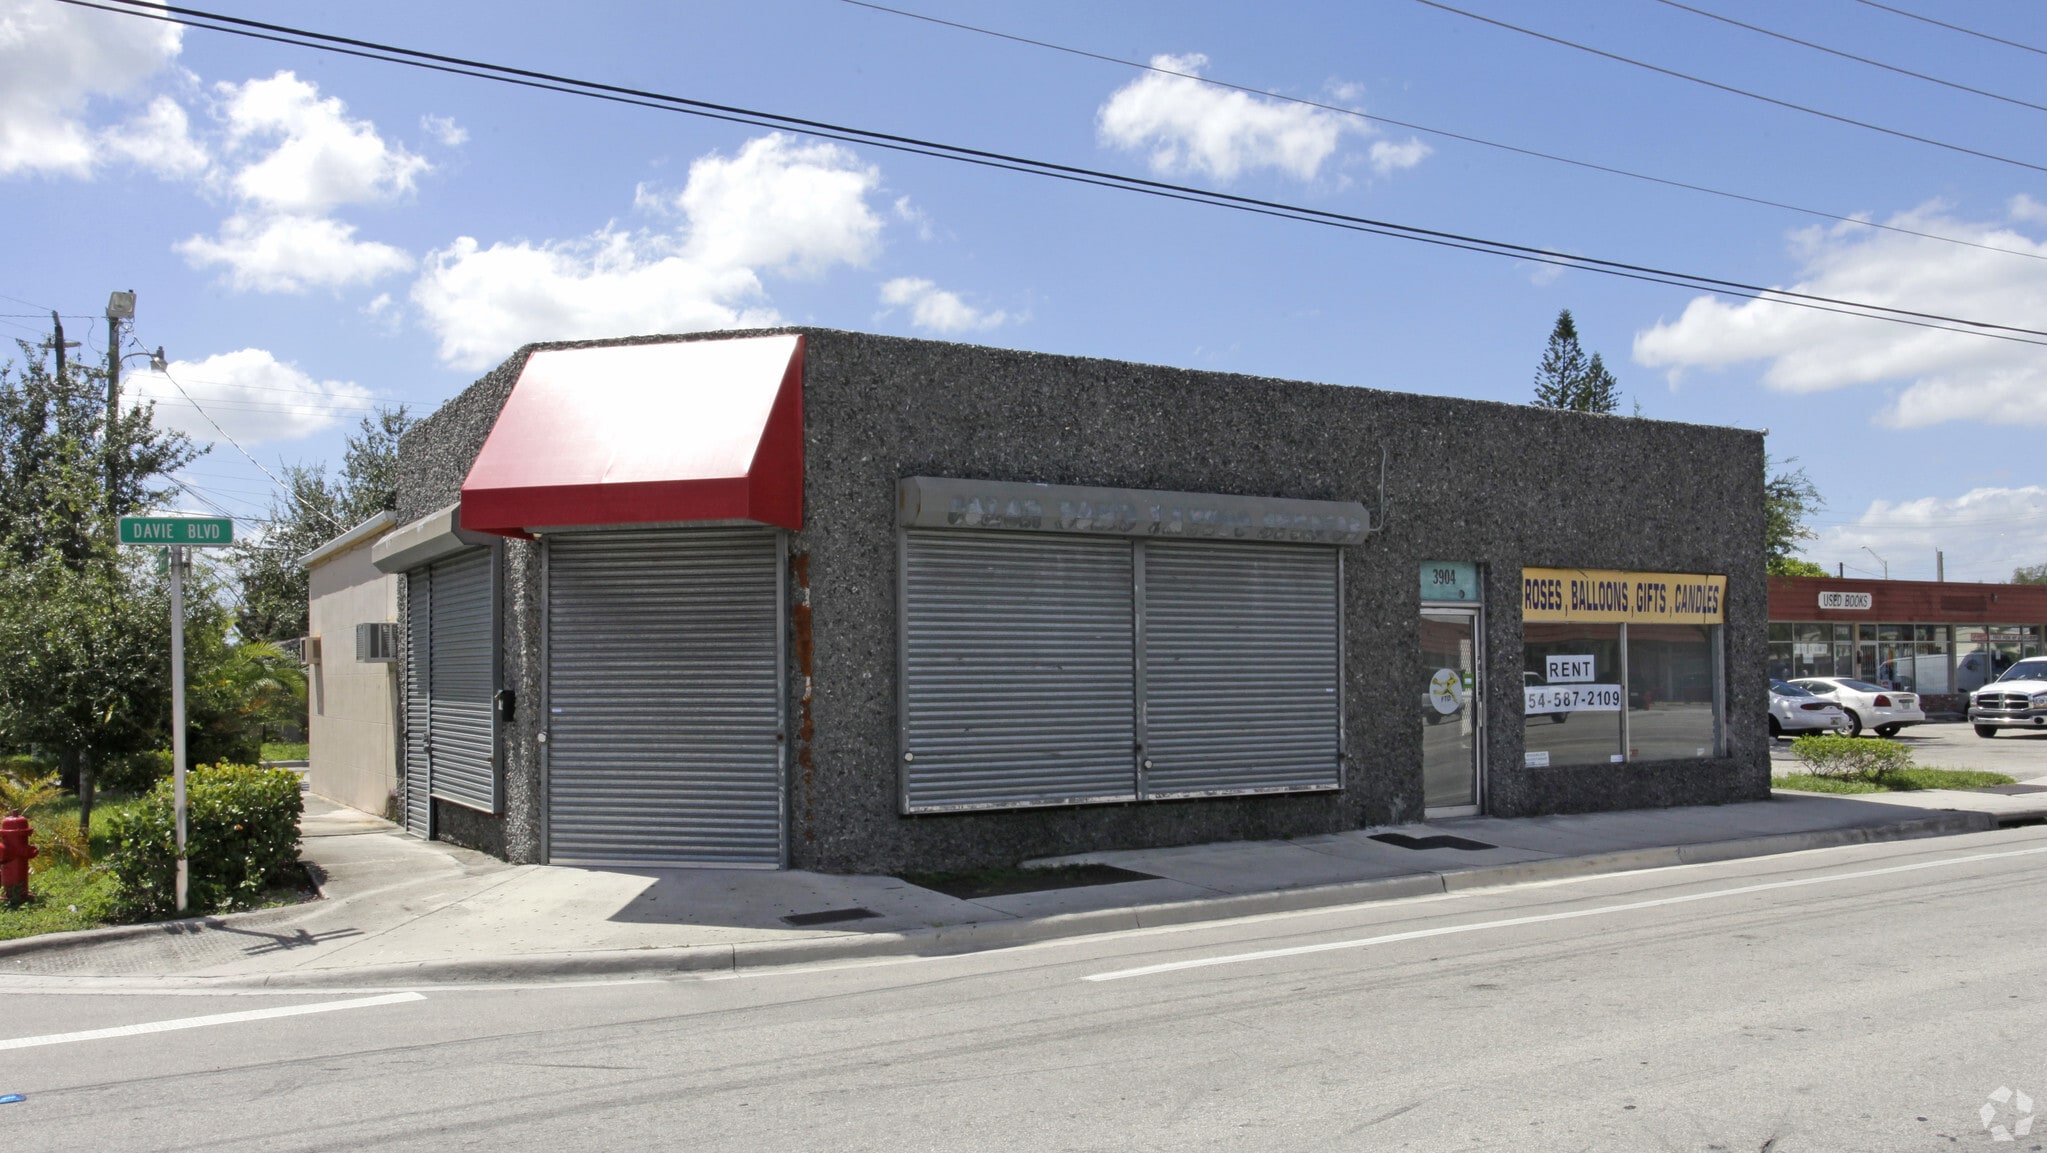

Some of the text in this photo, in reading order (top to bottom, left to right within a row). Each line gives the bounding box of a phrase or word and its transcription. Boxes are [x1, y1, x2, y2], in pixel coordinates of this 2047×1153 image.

[133, 523, 220, 539] DAVIE BLVD
[1432, 568, 1457, 586] 3904
[1674, 583, 1720, 614] CANDLES
[1823, 593, 1868, 608] USED BOOKS
[1549, 661, 1591, 678] RENT
